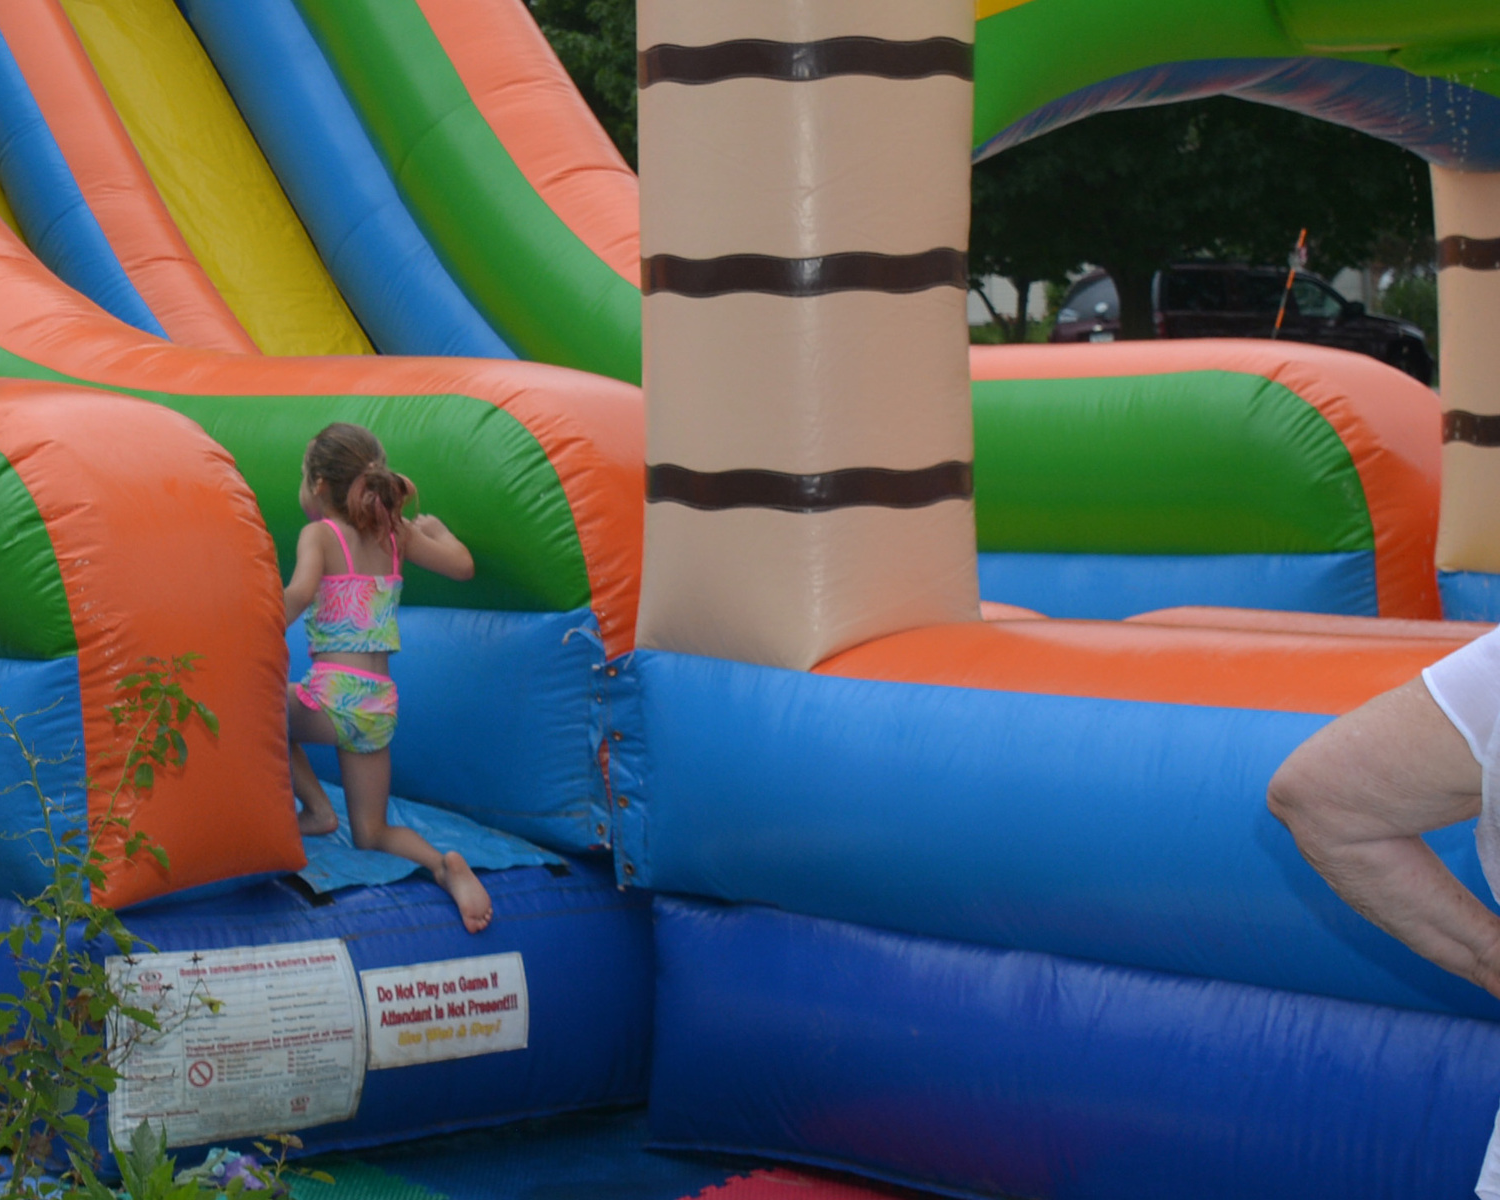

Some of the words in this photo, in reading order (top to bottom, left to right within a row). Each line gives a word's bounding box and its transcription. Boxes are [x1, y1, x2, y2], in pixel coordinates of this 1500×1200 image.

[377, 986, 393, 1003] Do
[395, 982, 414, 1000] Not
[417, 981, 440, 1000] Play
[443, 981, 456, 995] on
[458, 976, 488, 993] Game
[490, 972, 499, 988] If
[380, 1004, 432, 1028] Attendant
[448, 1002, 466, 1018] Not
